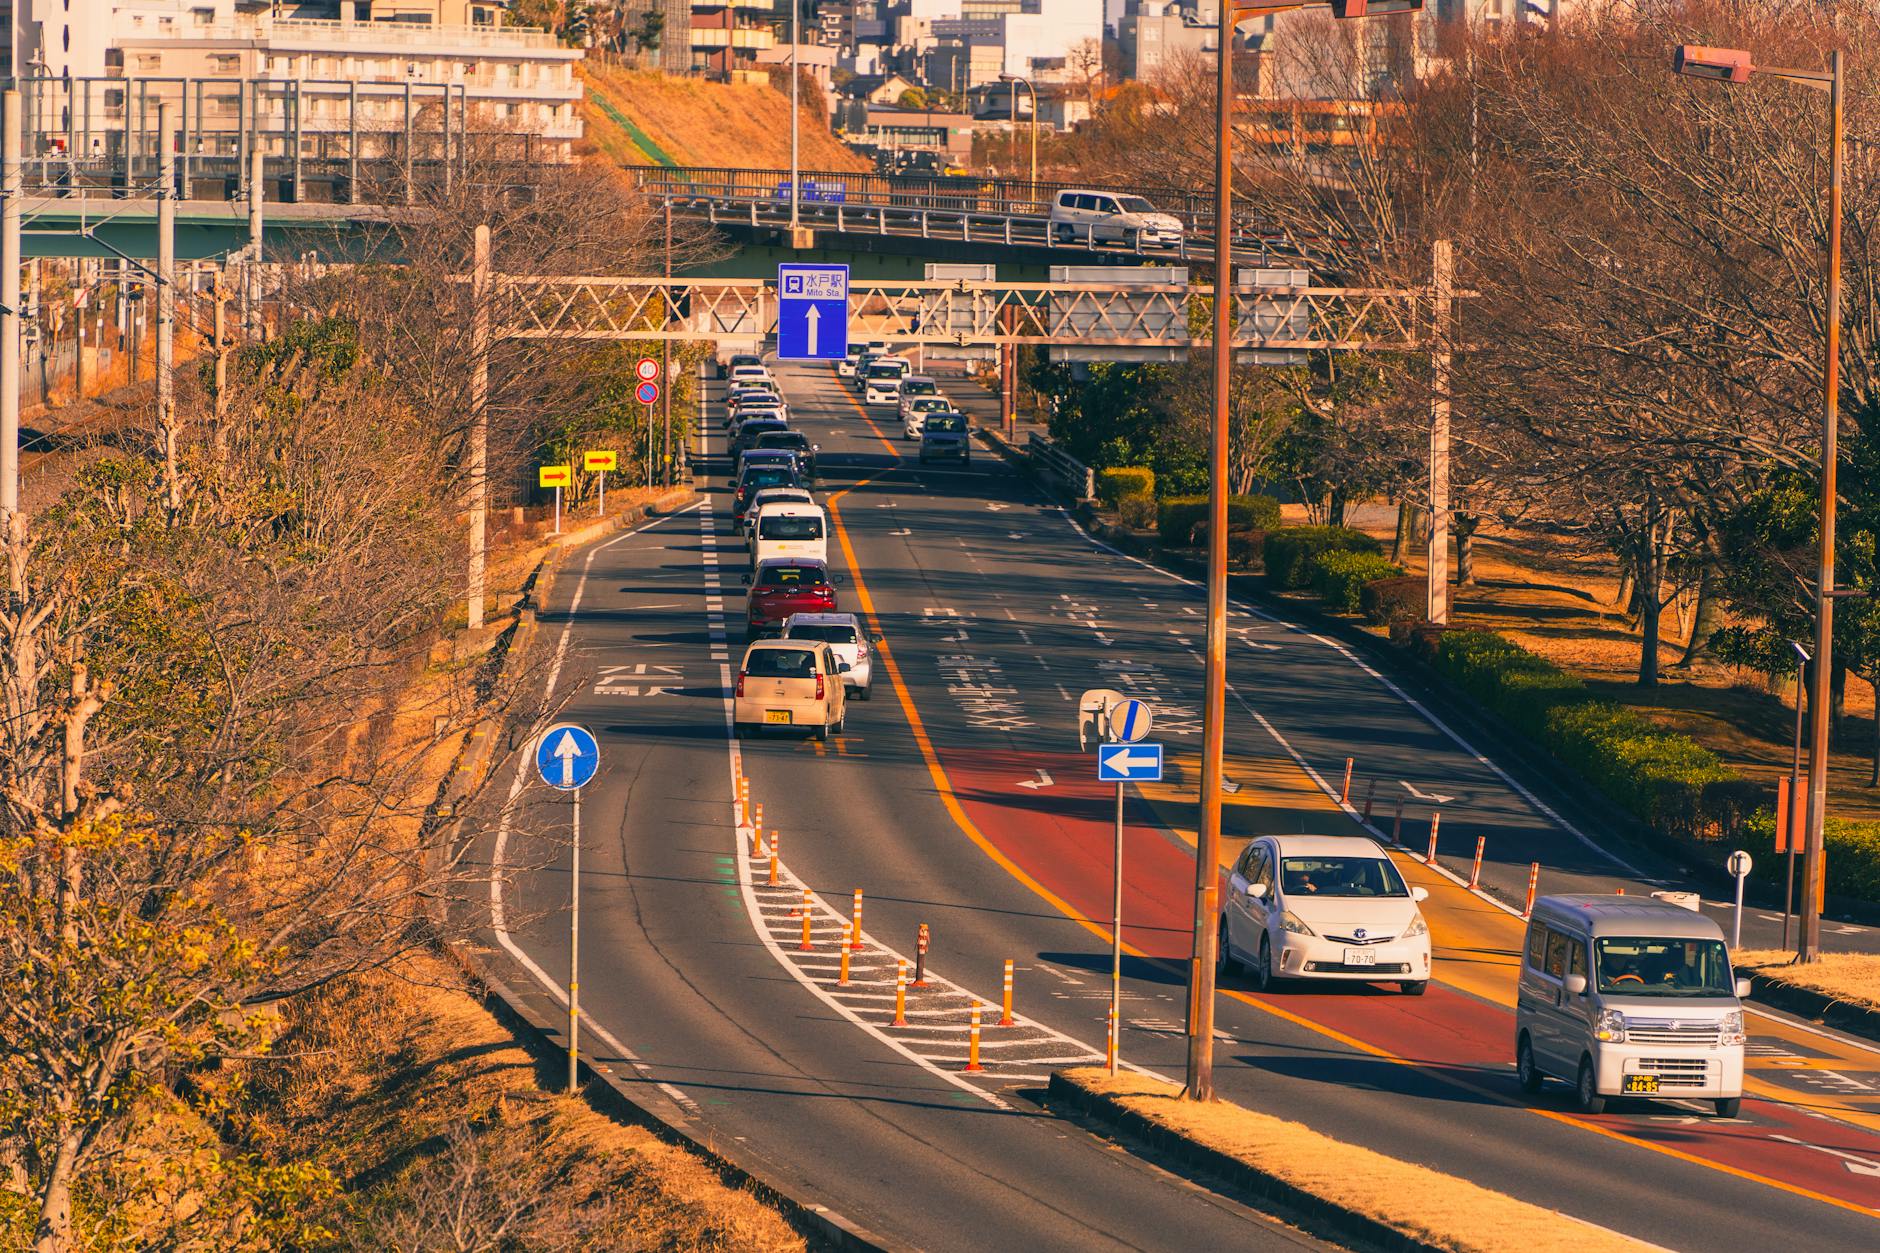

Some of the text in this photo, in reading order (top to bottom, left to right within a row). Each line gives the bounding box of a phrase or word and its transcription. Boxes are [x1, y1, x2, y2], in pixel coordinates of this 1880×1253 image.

[806, 274, 843, 287] 水戸駅
[806, 289, 842, 297] Mito Sta.
[642, 364, 654, 375] 40
[1351, 955, 1374, 964] 70-70
[1631, 1081, 1658, 1092] 84-85
